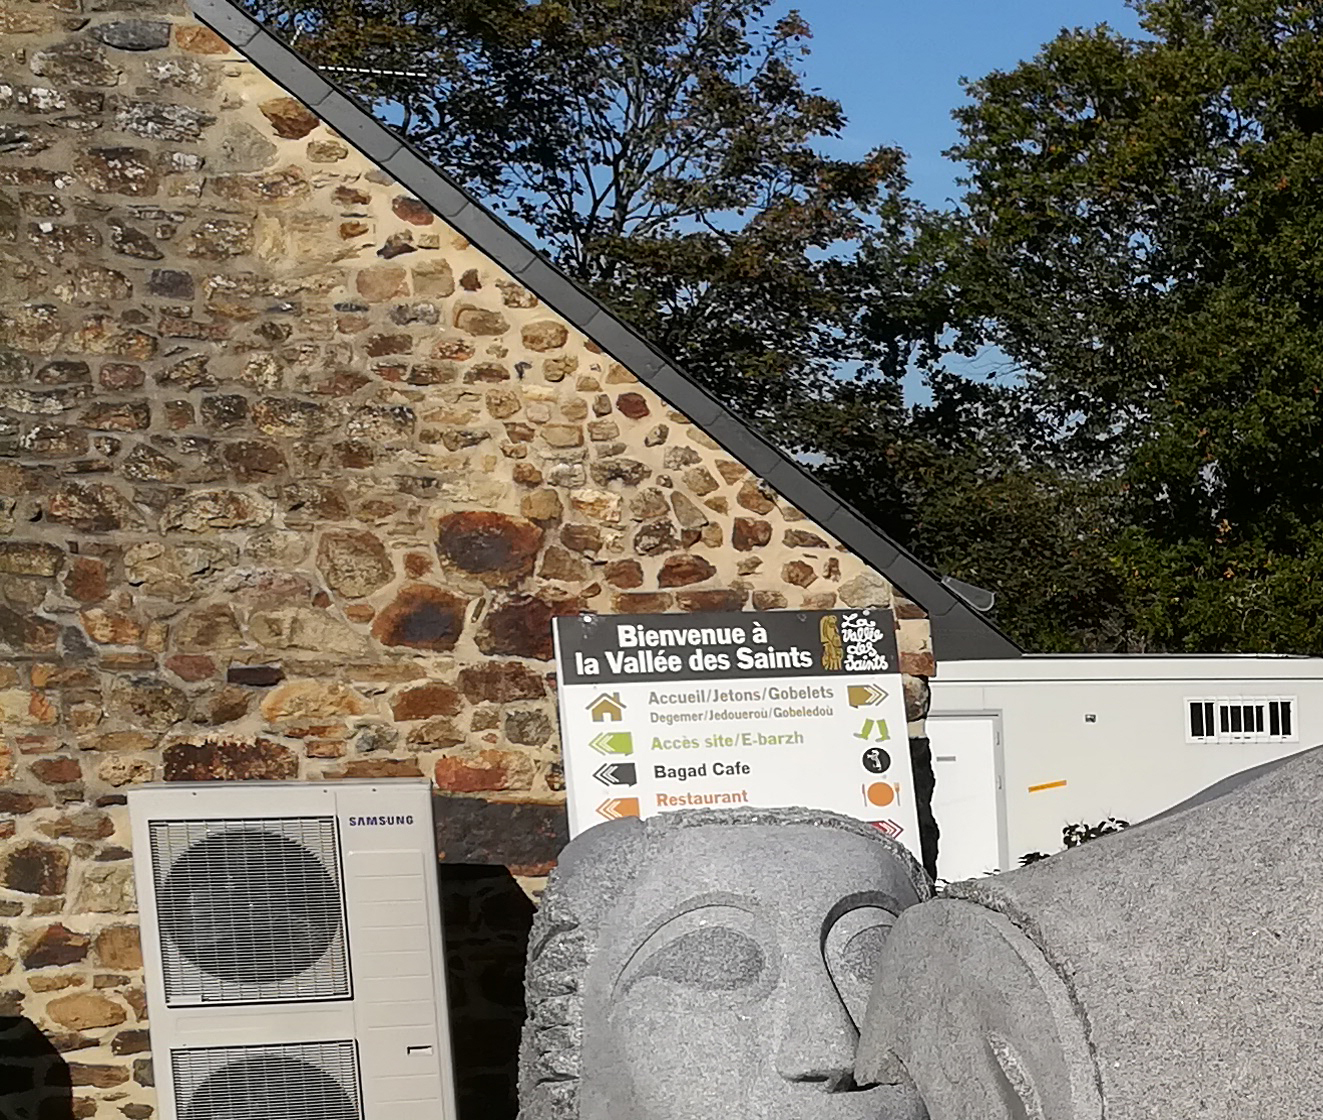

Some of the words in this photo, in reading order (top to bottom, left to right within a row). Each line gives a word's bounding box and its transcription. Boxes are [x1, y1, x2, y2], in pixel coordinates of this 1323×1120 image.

[617, 624, 746, 648] Bienvenue
[752, 621, 767, 644] à
[847, 642, 877, 656] des
[575, 652, 600, 675] la
[605, 649, 682, 674] Vallée
[689, 647, 730, 672] des
[737, 645, 813, 669] Saints
[648, 685, 834, 705] Accueil/Jetons/Gobelets
[651, 735, 700, 750] Accès
[704, 730, 804, 749] site/E-barzh
[654, 763, 707, 781] Bagad
[712, 761, 751, 776] Cafe
[656, 789, 749, 807] Restaurant
[349, 816, 414, 826] SAMSUNG
